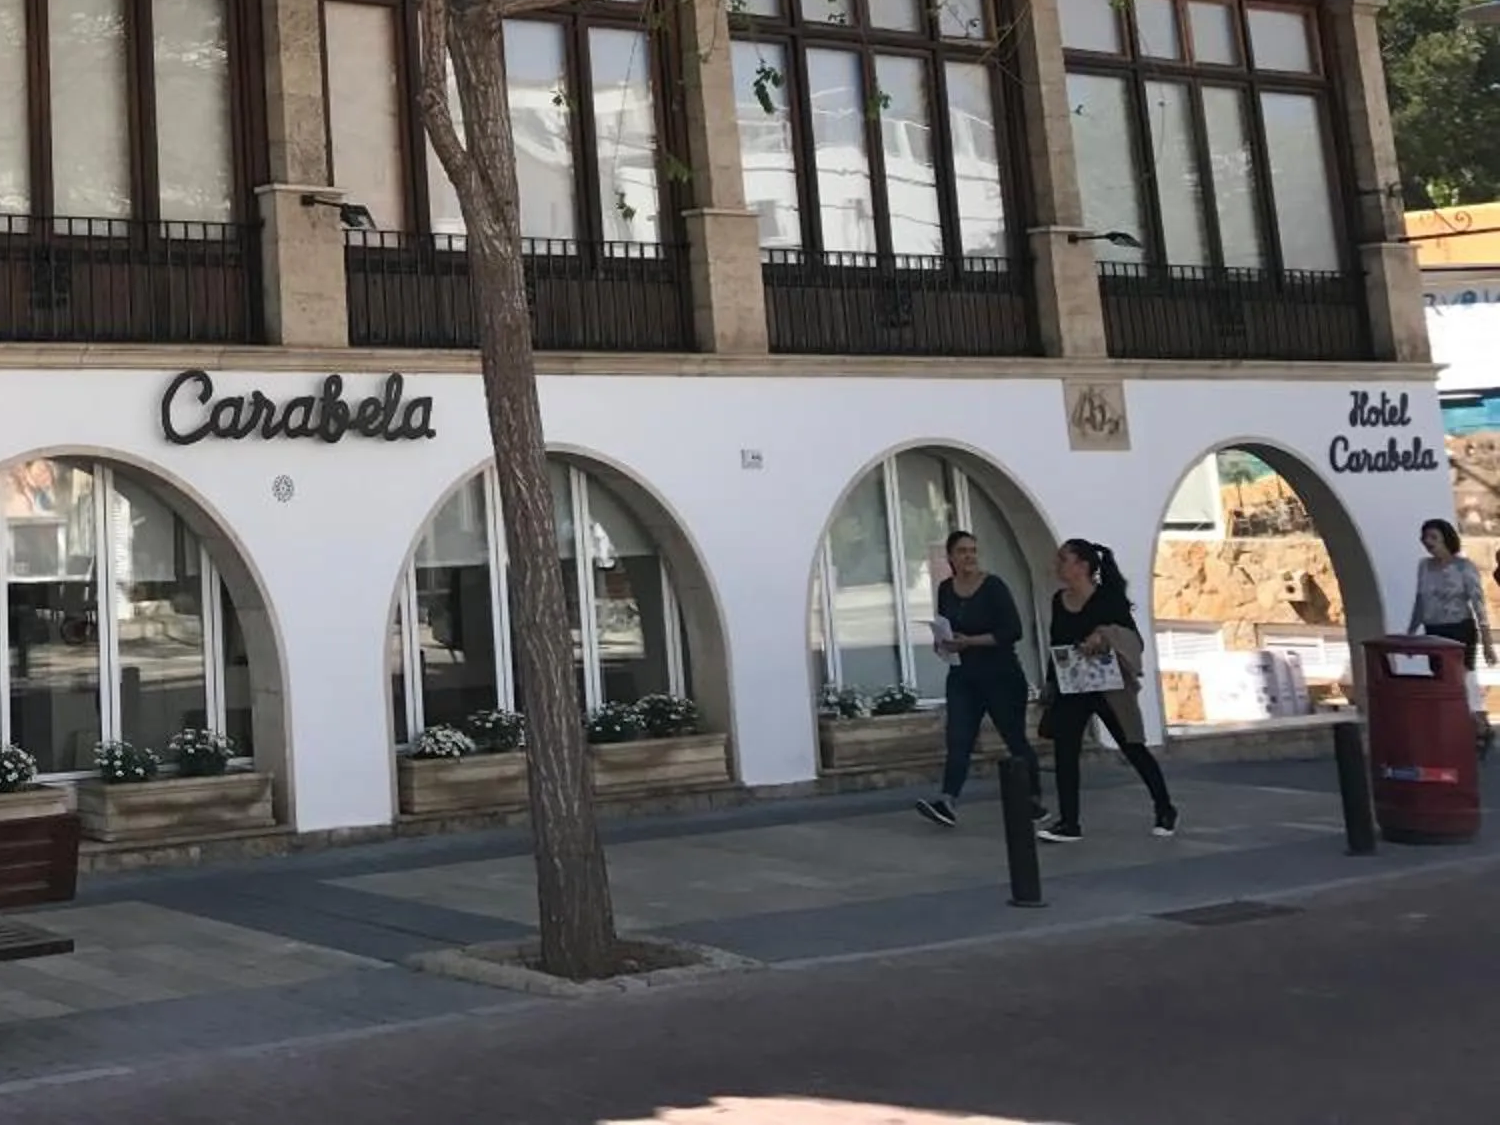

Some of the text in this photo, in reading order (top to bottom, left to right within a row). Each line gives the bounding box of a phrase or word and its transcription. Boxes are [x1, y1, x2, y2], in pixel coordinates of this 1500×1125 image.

[161, 369, 437, 445] Carabela
[1348, 389, 1412, 428] Hotel
[1329, 434, 1439, 473] Carabela
